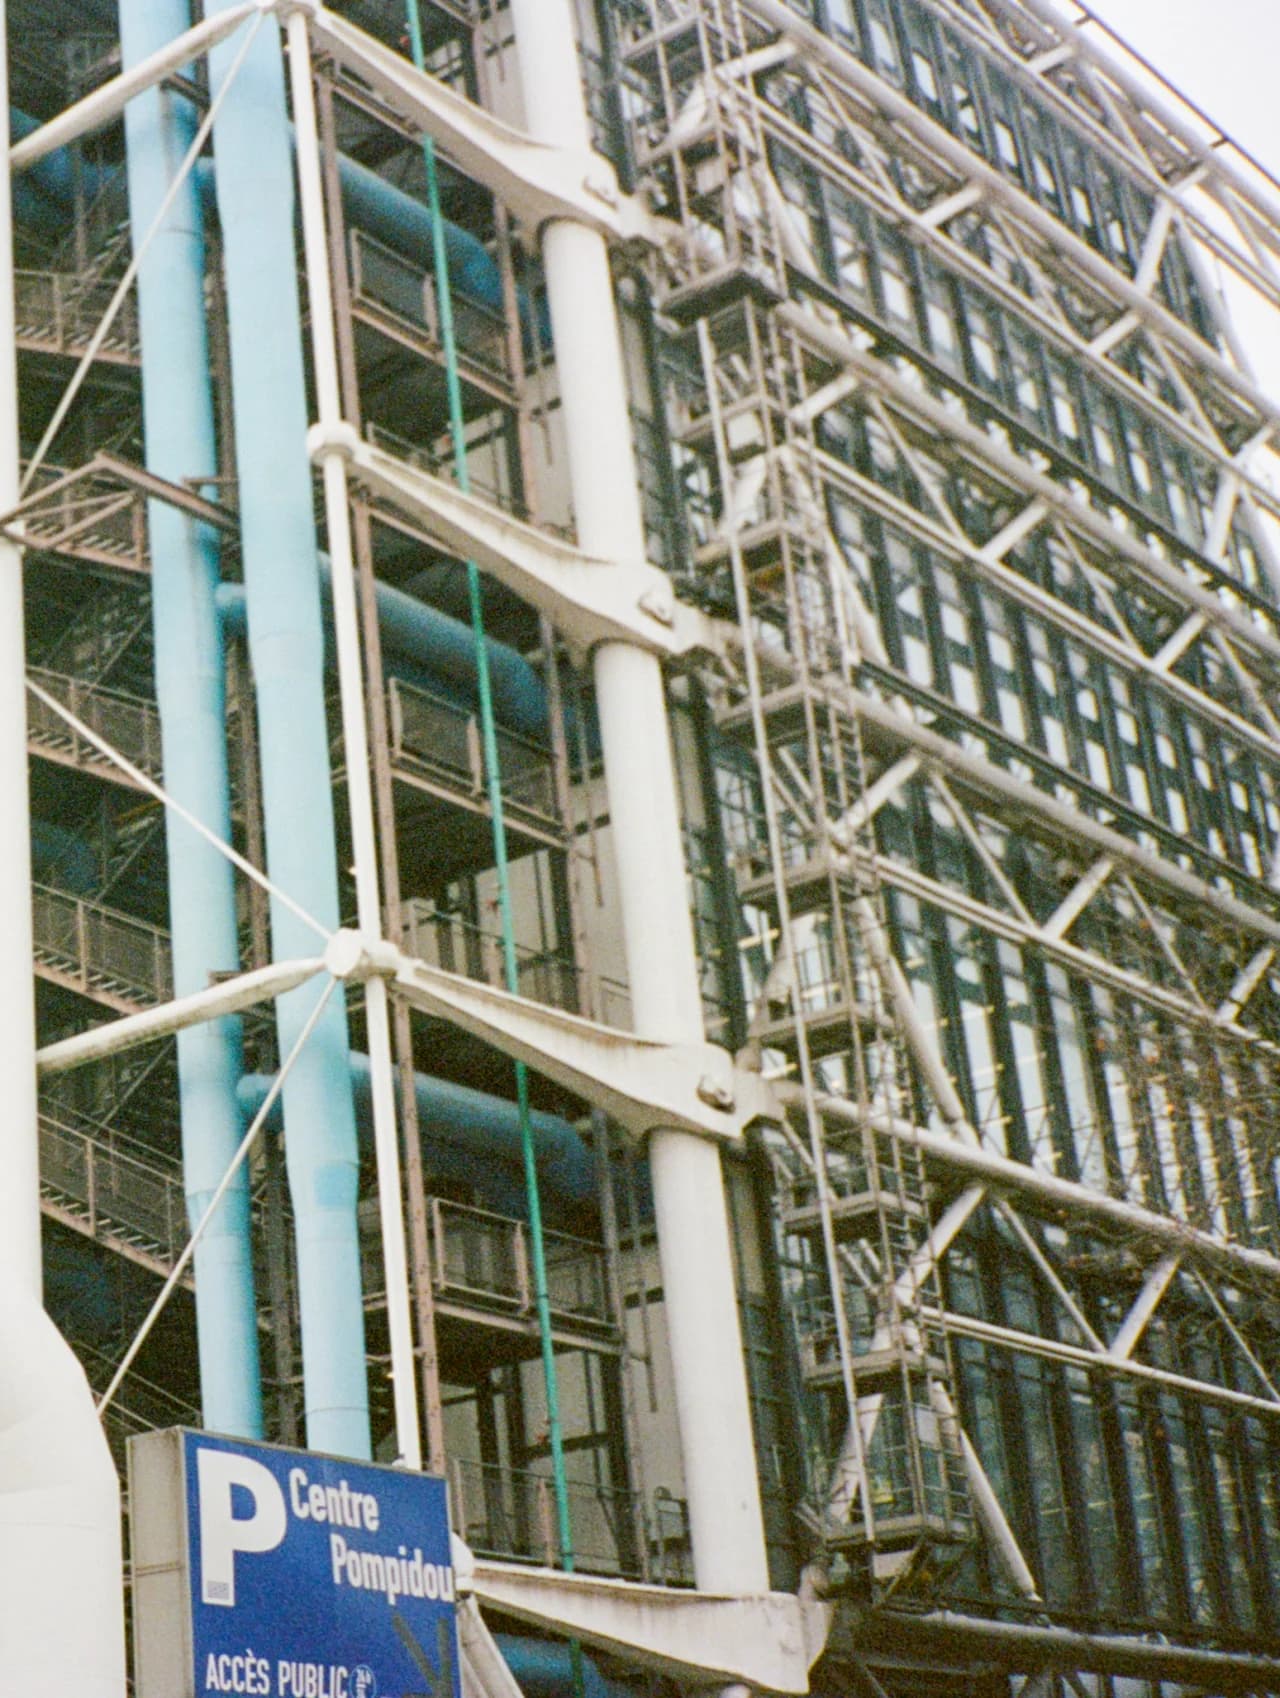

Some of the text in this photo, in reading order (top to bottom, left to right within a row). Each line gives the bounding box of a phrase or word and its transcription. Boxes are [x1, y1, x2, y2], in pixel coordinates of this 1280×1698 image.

[197, 1448, 286, 1606] P
[289, 1467, 379, 1531] Centre
[330, 1533, 454, 1605] Pompidou
[206, 1648, 269, 1695] ACCÈS
[278, 1660, 348, 1698] PUBLIC
